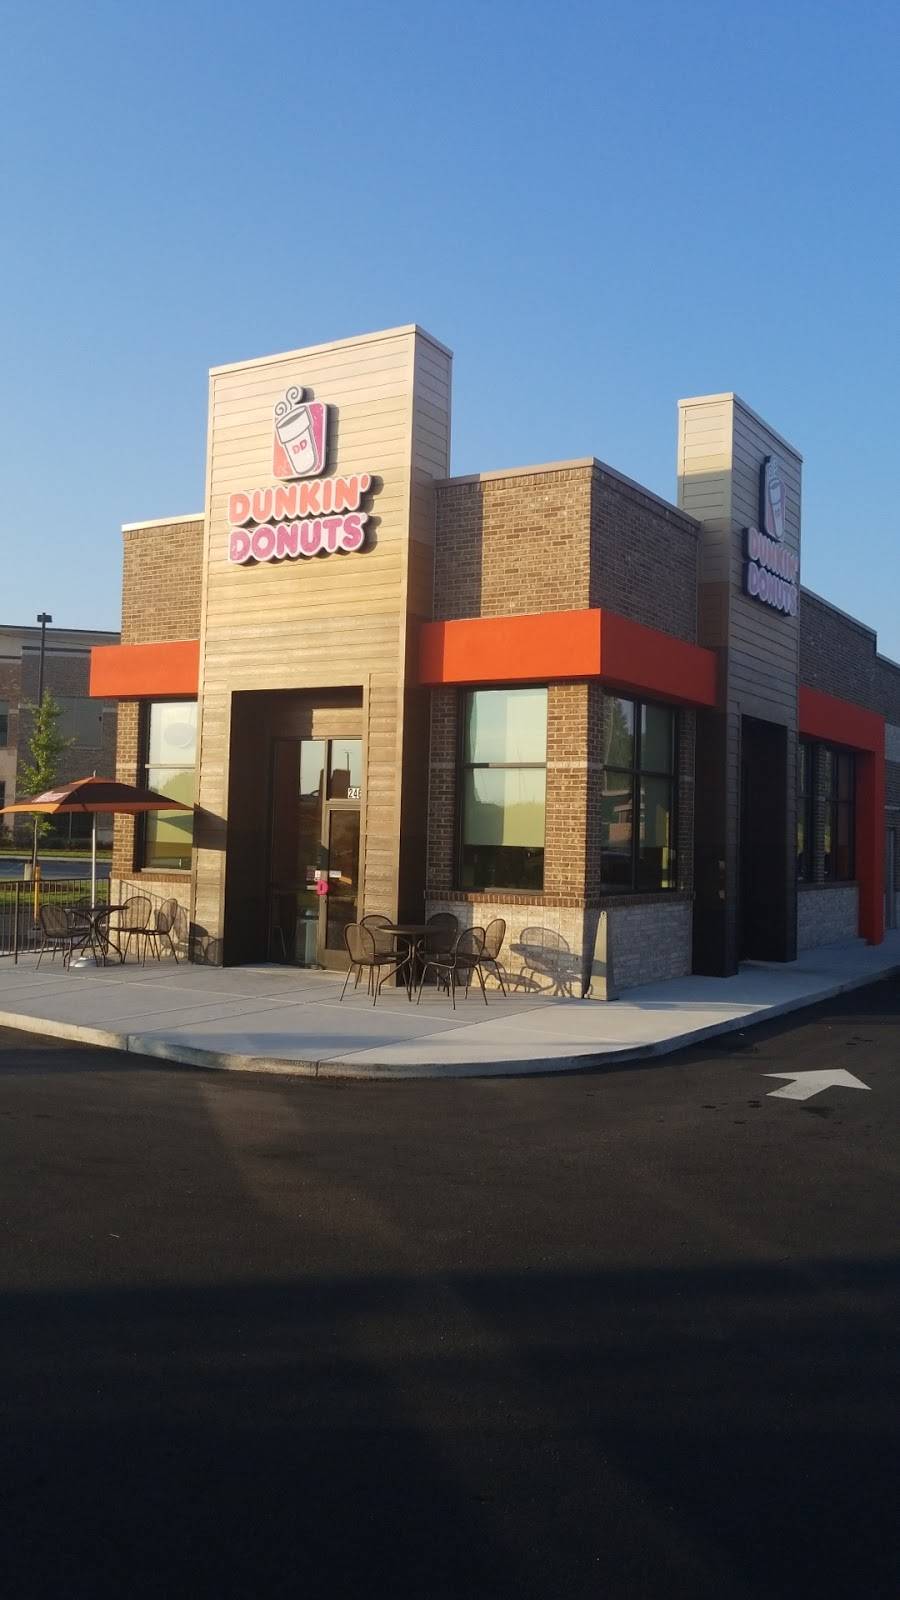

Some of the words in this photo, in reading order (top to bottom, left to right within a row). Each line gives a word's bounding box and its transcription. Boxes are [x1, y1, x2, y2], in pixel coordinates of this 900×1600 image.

[292, 439, 307, 454] DD
[229, 474, 370, 523] DUNKIN'
[230, 515, 364, 561] DONUTS
[749, 562, 797, 616] DONUTS
